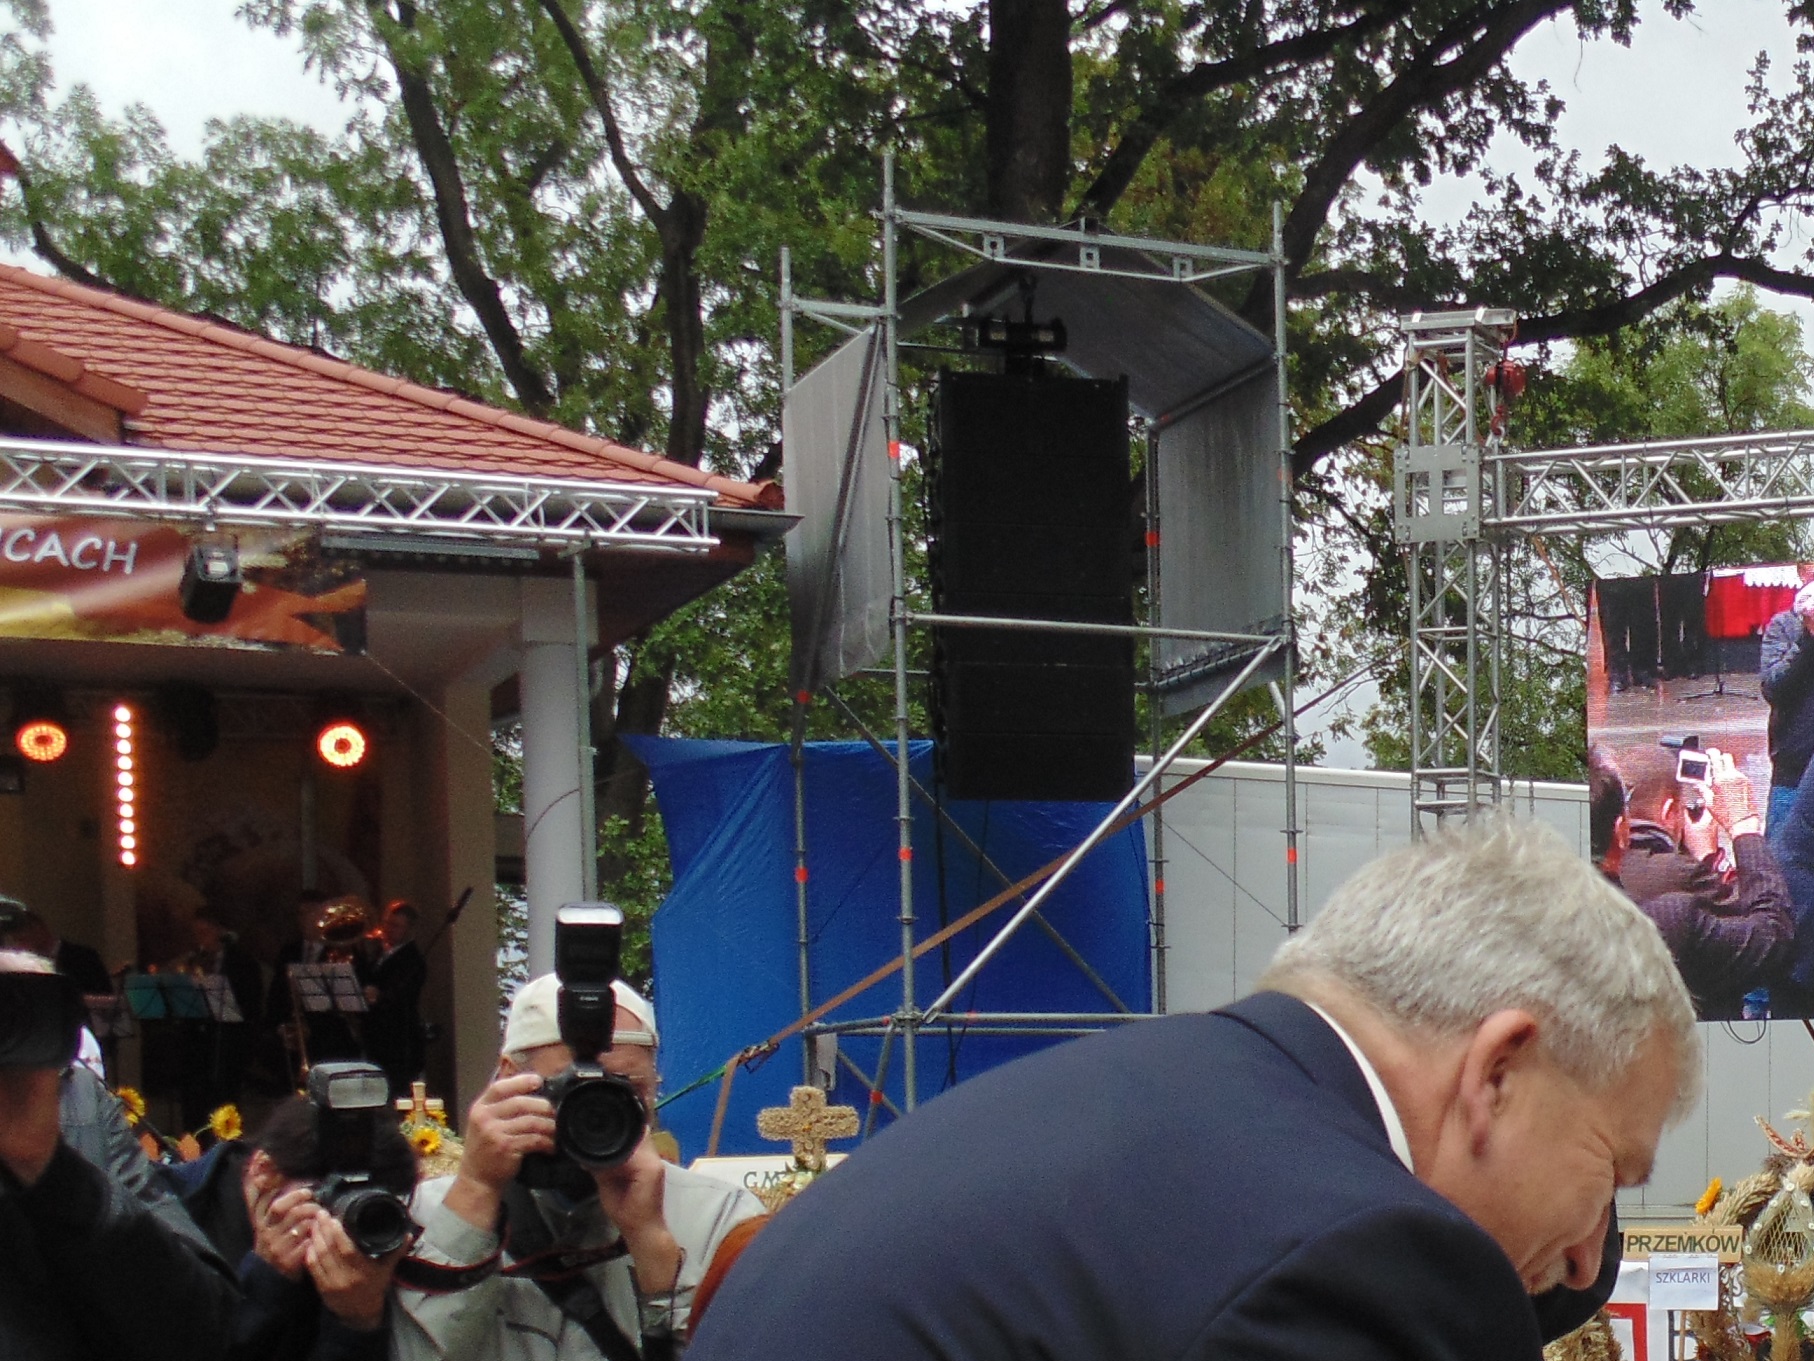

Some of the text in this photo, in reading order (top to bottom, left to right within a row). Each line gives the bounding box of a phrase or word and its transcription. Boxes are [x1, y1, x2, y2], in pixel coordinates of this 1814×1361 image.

[0, 526, 138, 575] CACH
[1626, 1228, 1740, 1253] PRZEMKÓW
[1656, 1272, 1710, 1284] SZKLARKI
